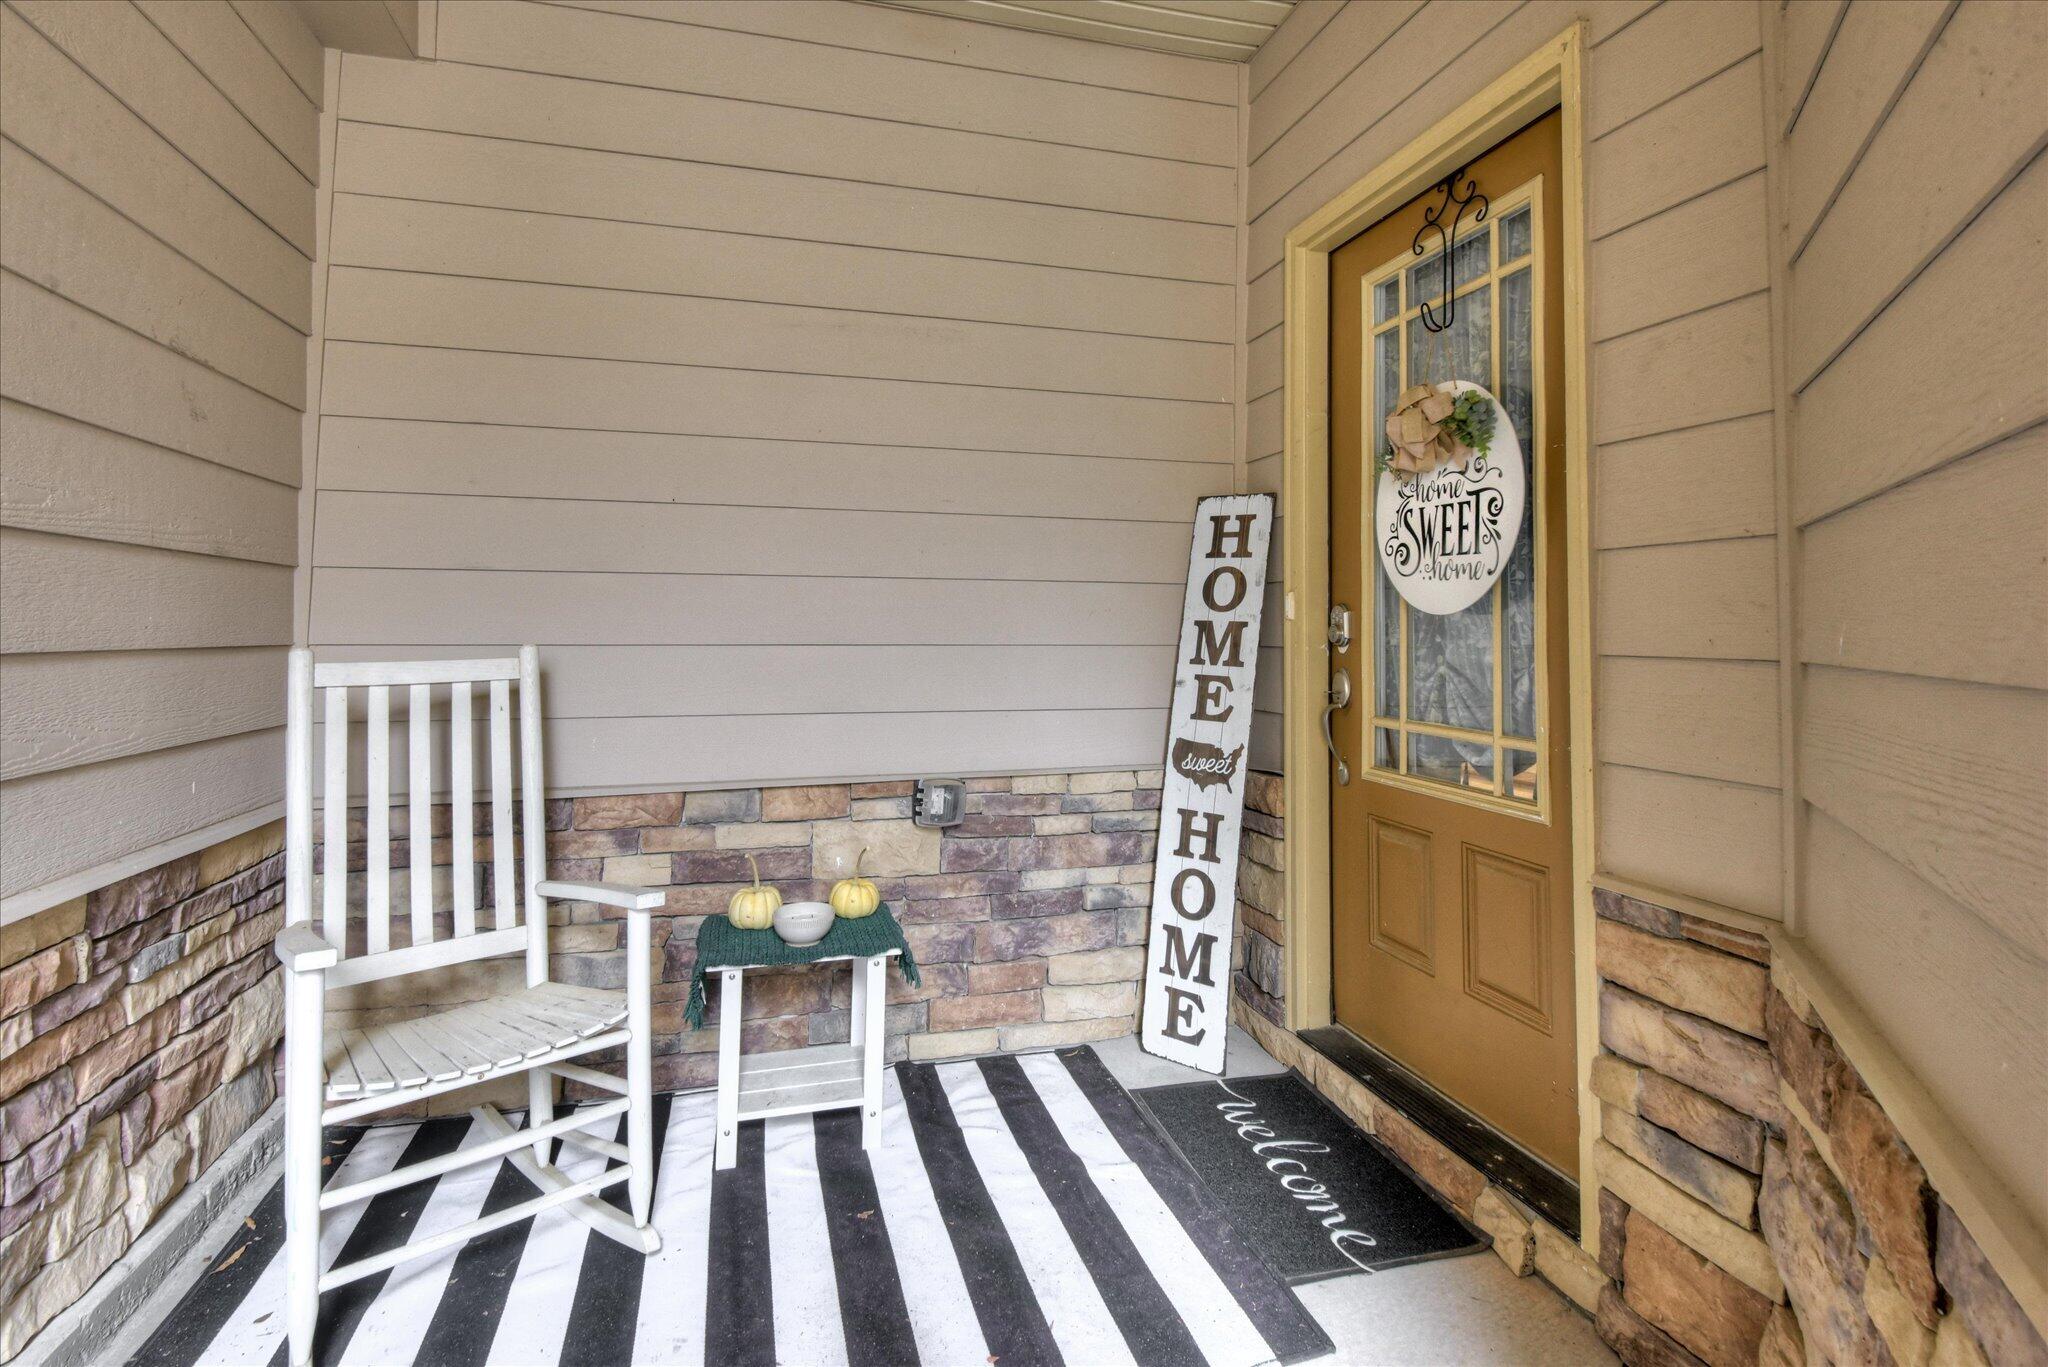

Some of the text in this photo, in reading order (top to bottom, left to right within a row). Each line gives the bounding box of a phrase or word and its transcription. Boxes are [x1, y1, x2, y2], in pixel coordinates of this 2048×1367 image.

[1394, 487, 1503, 576] SWEET
[1410, 472, 1465, 503] home
[1425, 541, 1485, 581] home
[1189, 513, 1257, 723] HOME
[1181, 752, 1233, 775] sweet
[1159, 807, 1225, 1047] HOME
[1216, 1079, 1377, 1274] welcome
